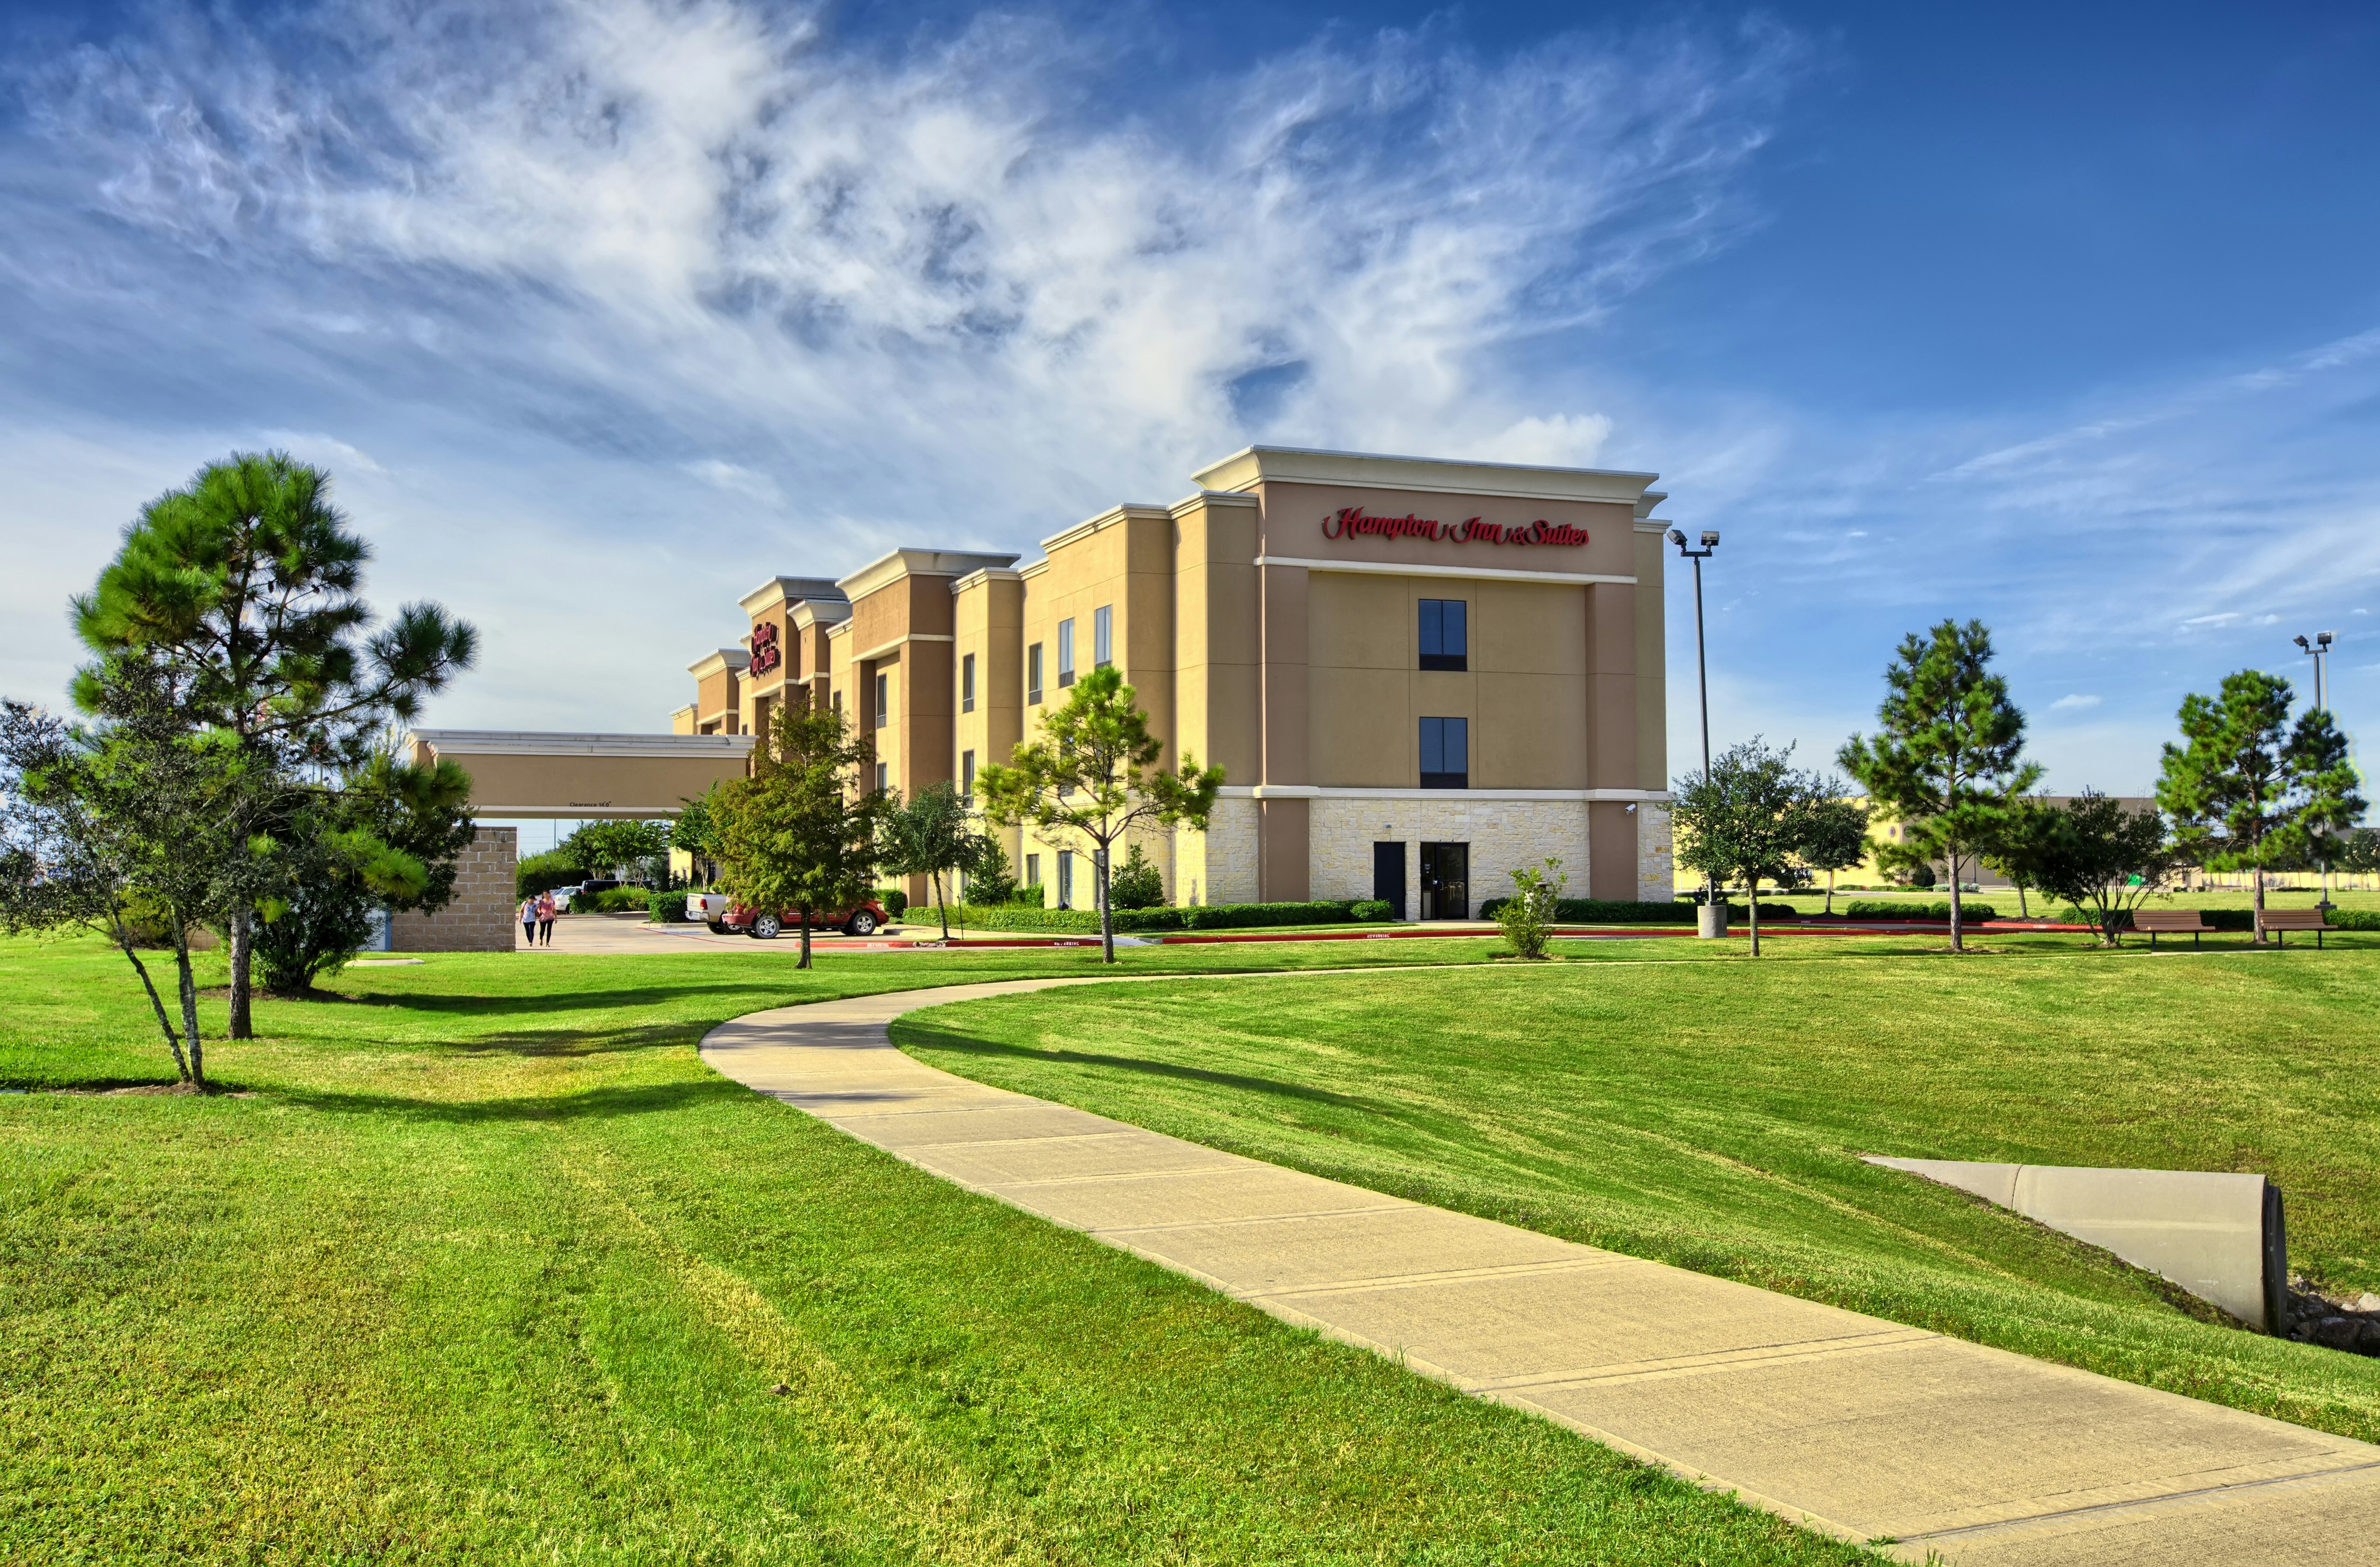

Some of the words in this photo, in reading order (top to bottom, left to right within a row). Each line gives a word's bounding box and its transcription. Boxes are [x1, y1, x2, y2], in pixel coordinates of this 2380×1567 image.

[1323, 506, 1449, 542] Hampton
[1449, 516, 1513, 545] Inn
[1512, 526, 1527, 546] &
[1524, 519, 1589, 546] Suites
